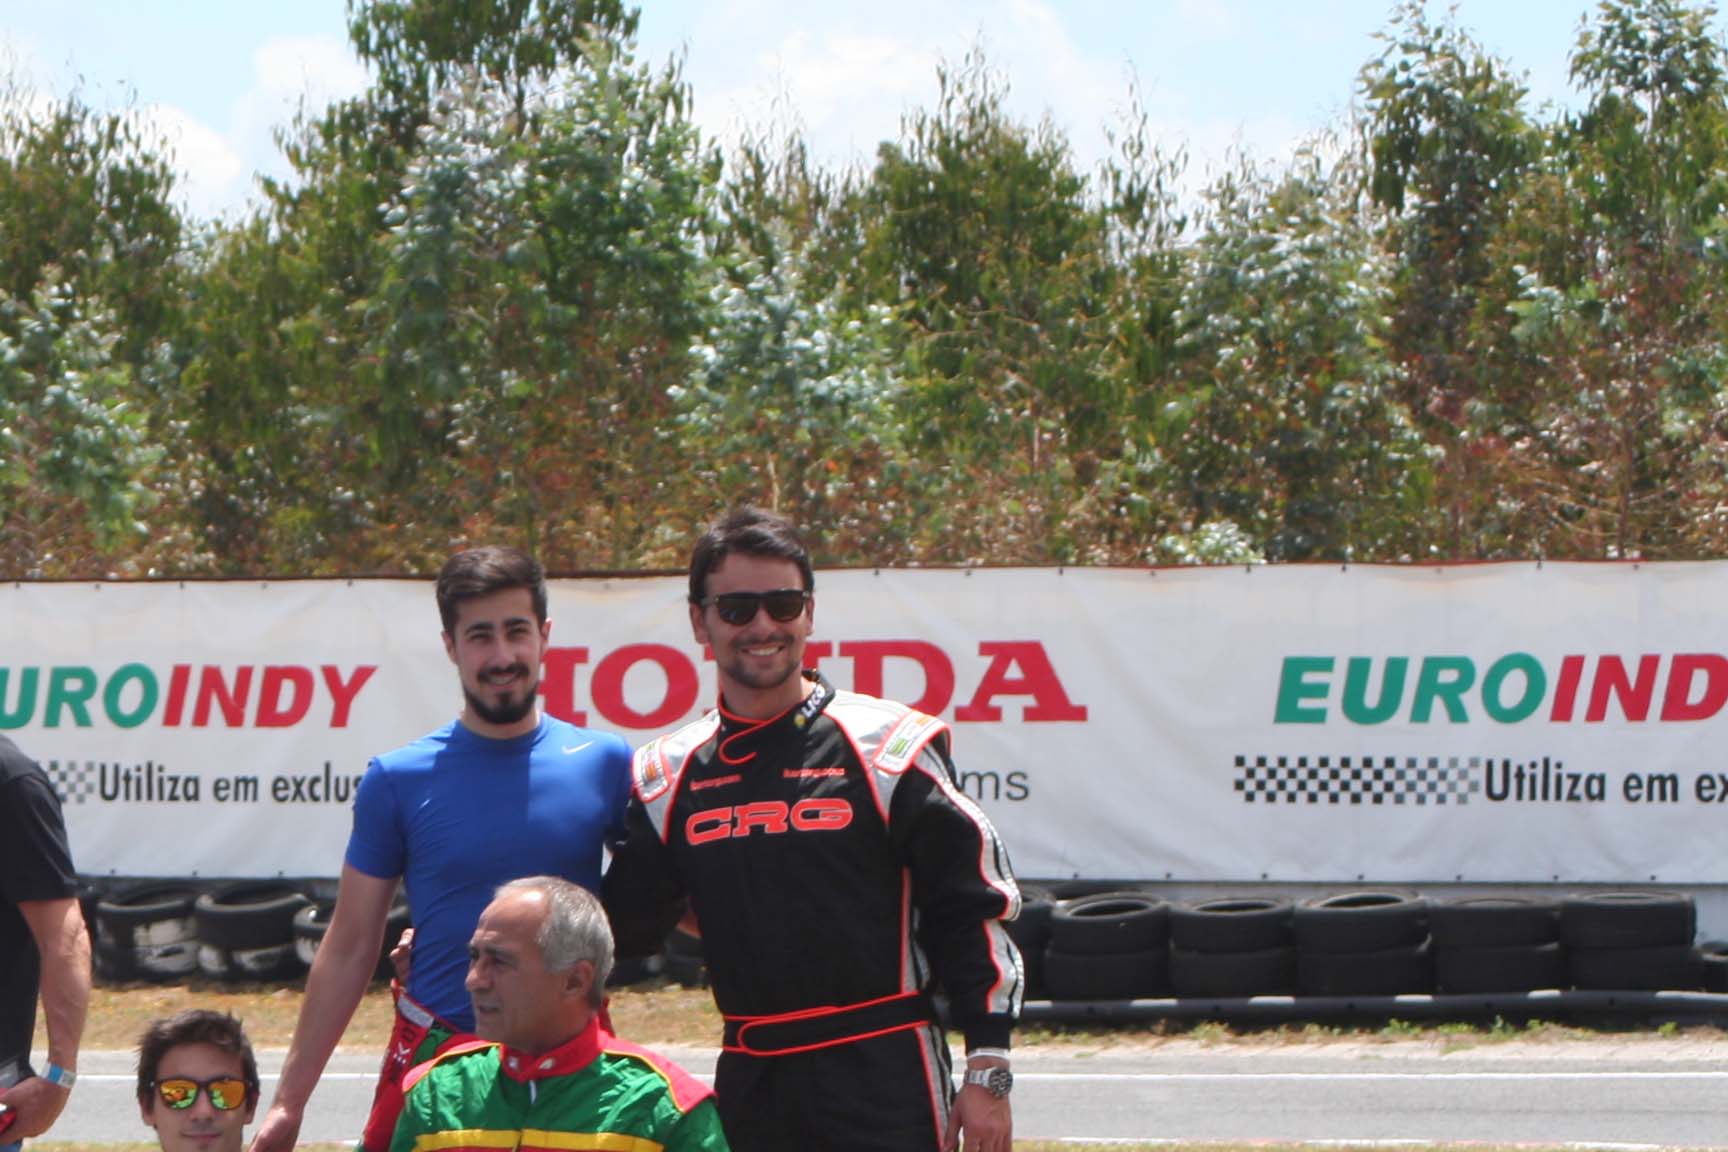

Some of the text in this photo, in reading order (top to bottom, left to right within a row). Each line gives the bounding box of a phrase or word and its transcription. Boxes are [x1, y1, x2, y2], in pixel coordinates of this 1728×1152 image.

[537, 640, 1087, 730] HODA
[99, 759, 200, 804] Utiliza
[213, 775, 258, 801] em
[1485, 757, 1606, 802] Utiliza
[1623, 772, 1679, 802] em
[686, 799, 854, 845] CRG
